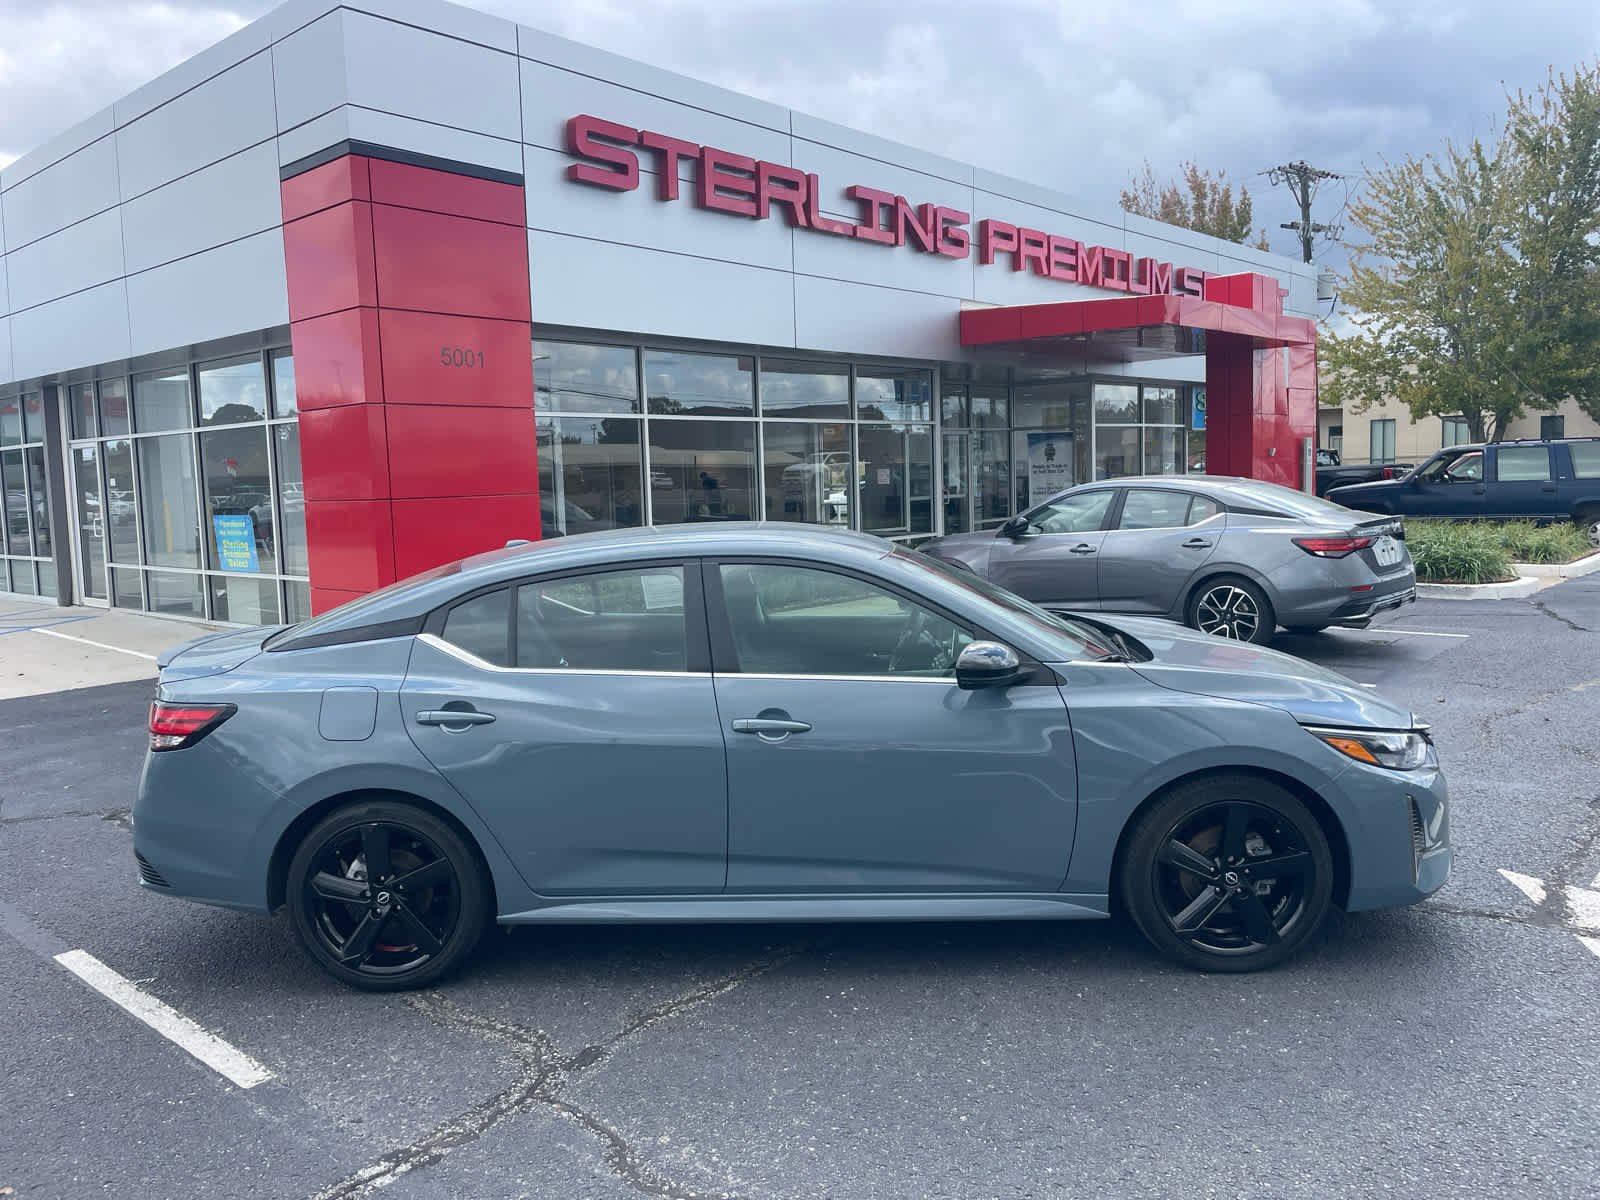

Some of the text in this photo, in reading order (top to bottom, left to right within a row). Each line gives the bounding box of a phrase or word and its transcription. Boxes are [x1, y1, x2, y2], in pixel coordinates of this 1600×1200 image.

[567, 113, 1173, 295] STERLING PREMIUM
[441, 347, 485, 368] 5001
